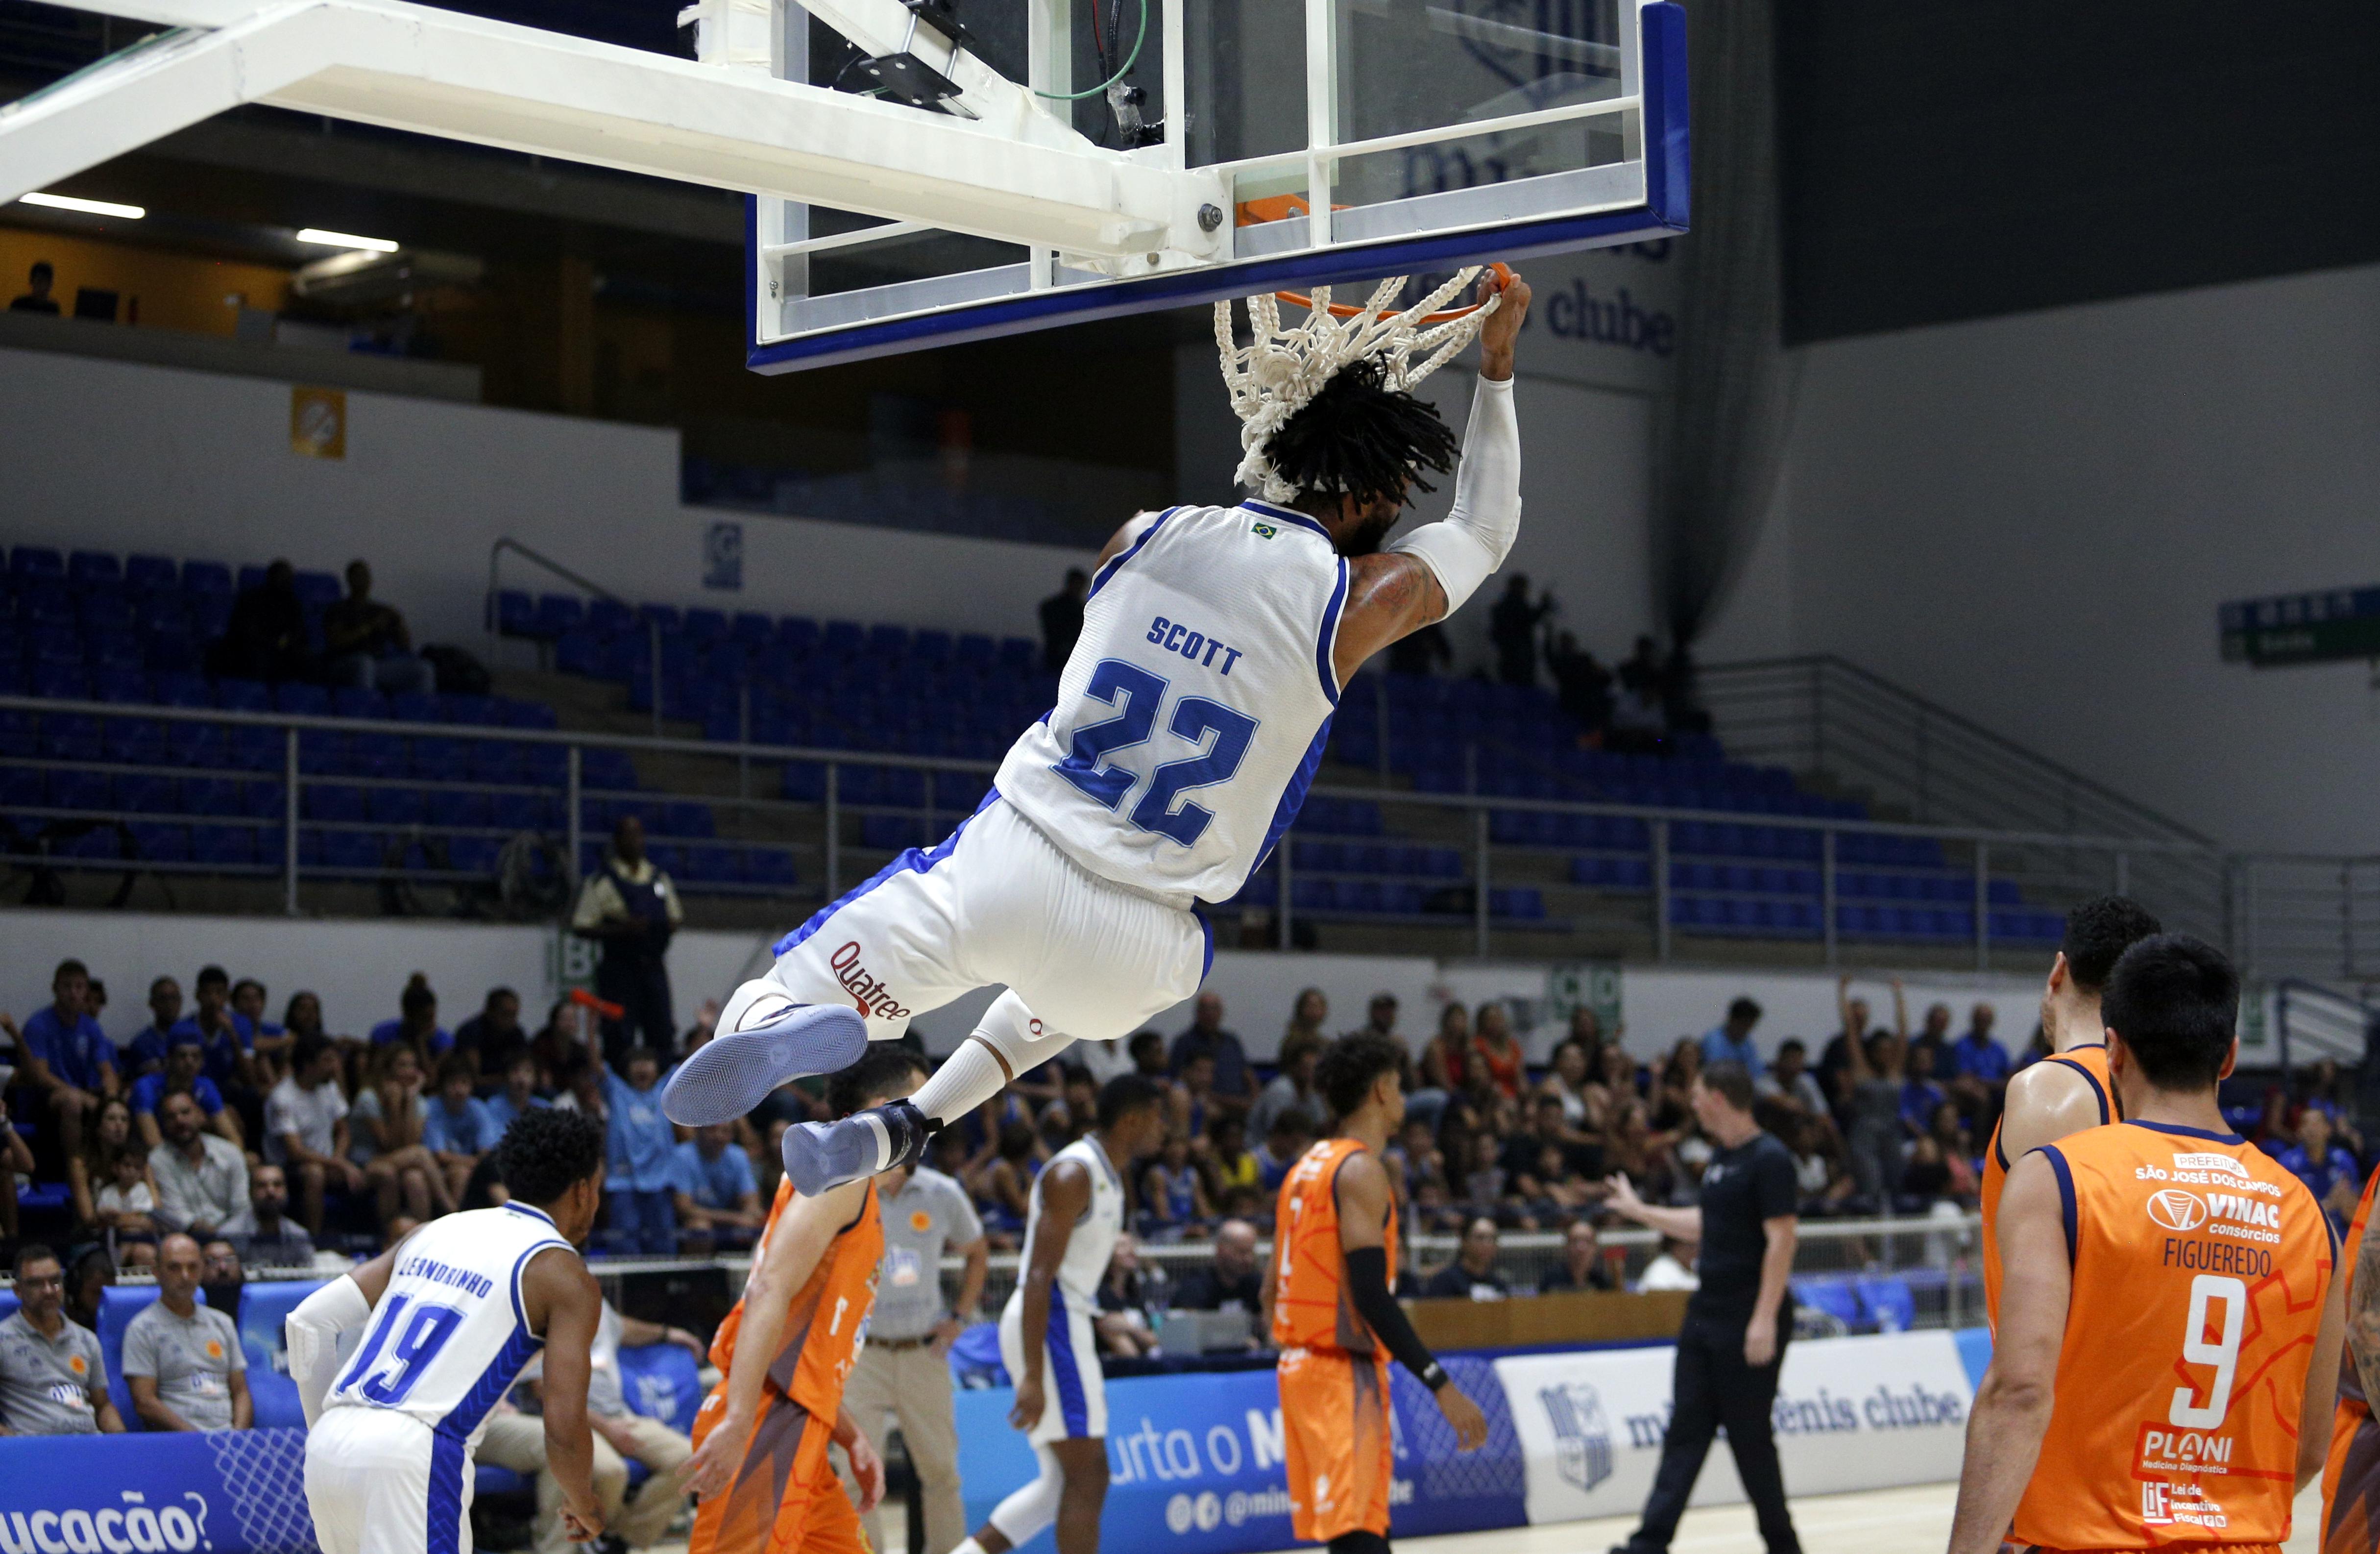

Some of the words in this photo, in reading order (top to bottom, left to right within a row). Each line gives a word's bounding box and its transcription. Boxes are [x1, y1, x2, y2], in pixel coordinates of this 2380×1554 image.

[1546, 276, 1674, 356] clube
[1147, 616, 1242, 676] SCOTT
[1050, 659, 1261, 848] 22
[831, 941, 910, 1020] Quatree
[2135, 1164, 2167, 1180] SÃO
[2171, 1170, 2209, 1184] JOSÉ
[2211, 1173, 2236, 1188] DOS
[2237, 1179, 2281, 1197] CAMPOS
[2180, 1156, 2243, 1175] PREFEITURA
[2206, 1193, 2279, 1229] VINAC
[2209, 1223, 2281, 1244] consórcios
[2163, 1238, 2271, 1277] FIGUEREDO
[399, 1258, 493, 1298] LEANDRINHO
[336, 1291, 468, 1409] 19
[2169, 1274, 2246, 1430] 9
[1770, 1387, 1858, 1434] ênis
[1863, 1381, 1965, 1428] clube
[1206, 1425, 1242, 1477] o
[2144, 1431, 2233, 1463] PLANI
[2142, 1460, 2178, 1470] Medicina
[2179, 1463, 2228, 1474] Diagnóstica
[2171, 1483, 2186, 1496] Lei
[2187, 1484, 2203, 1496] de
[2173, 1513, 2204, 1526] Fiscal
